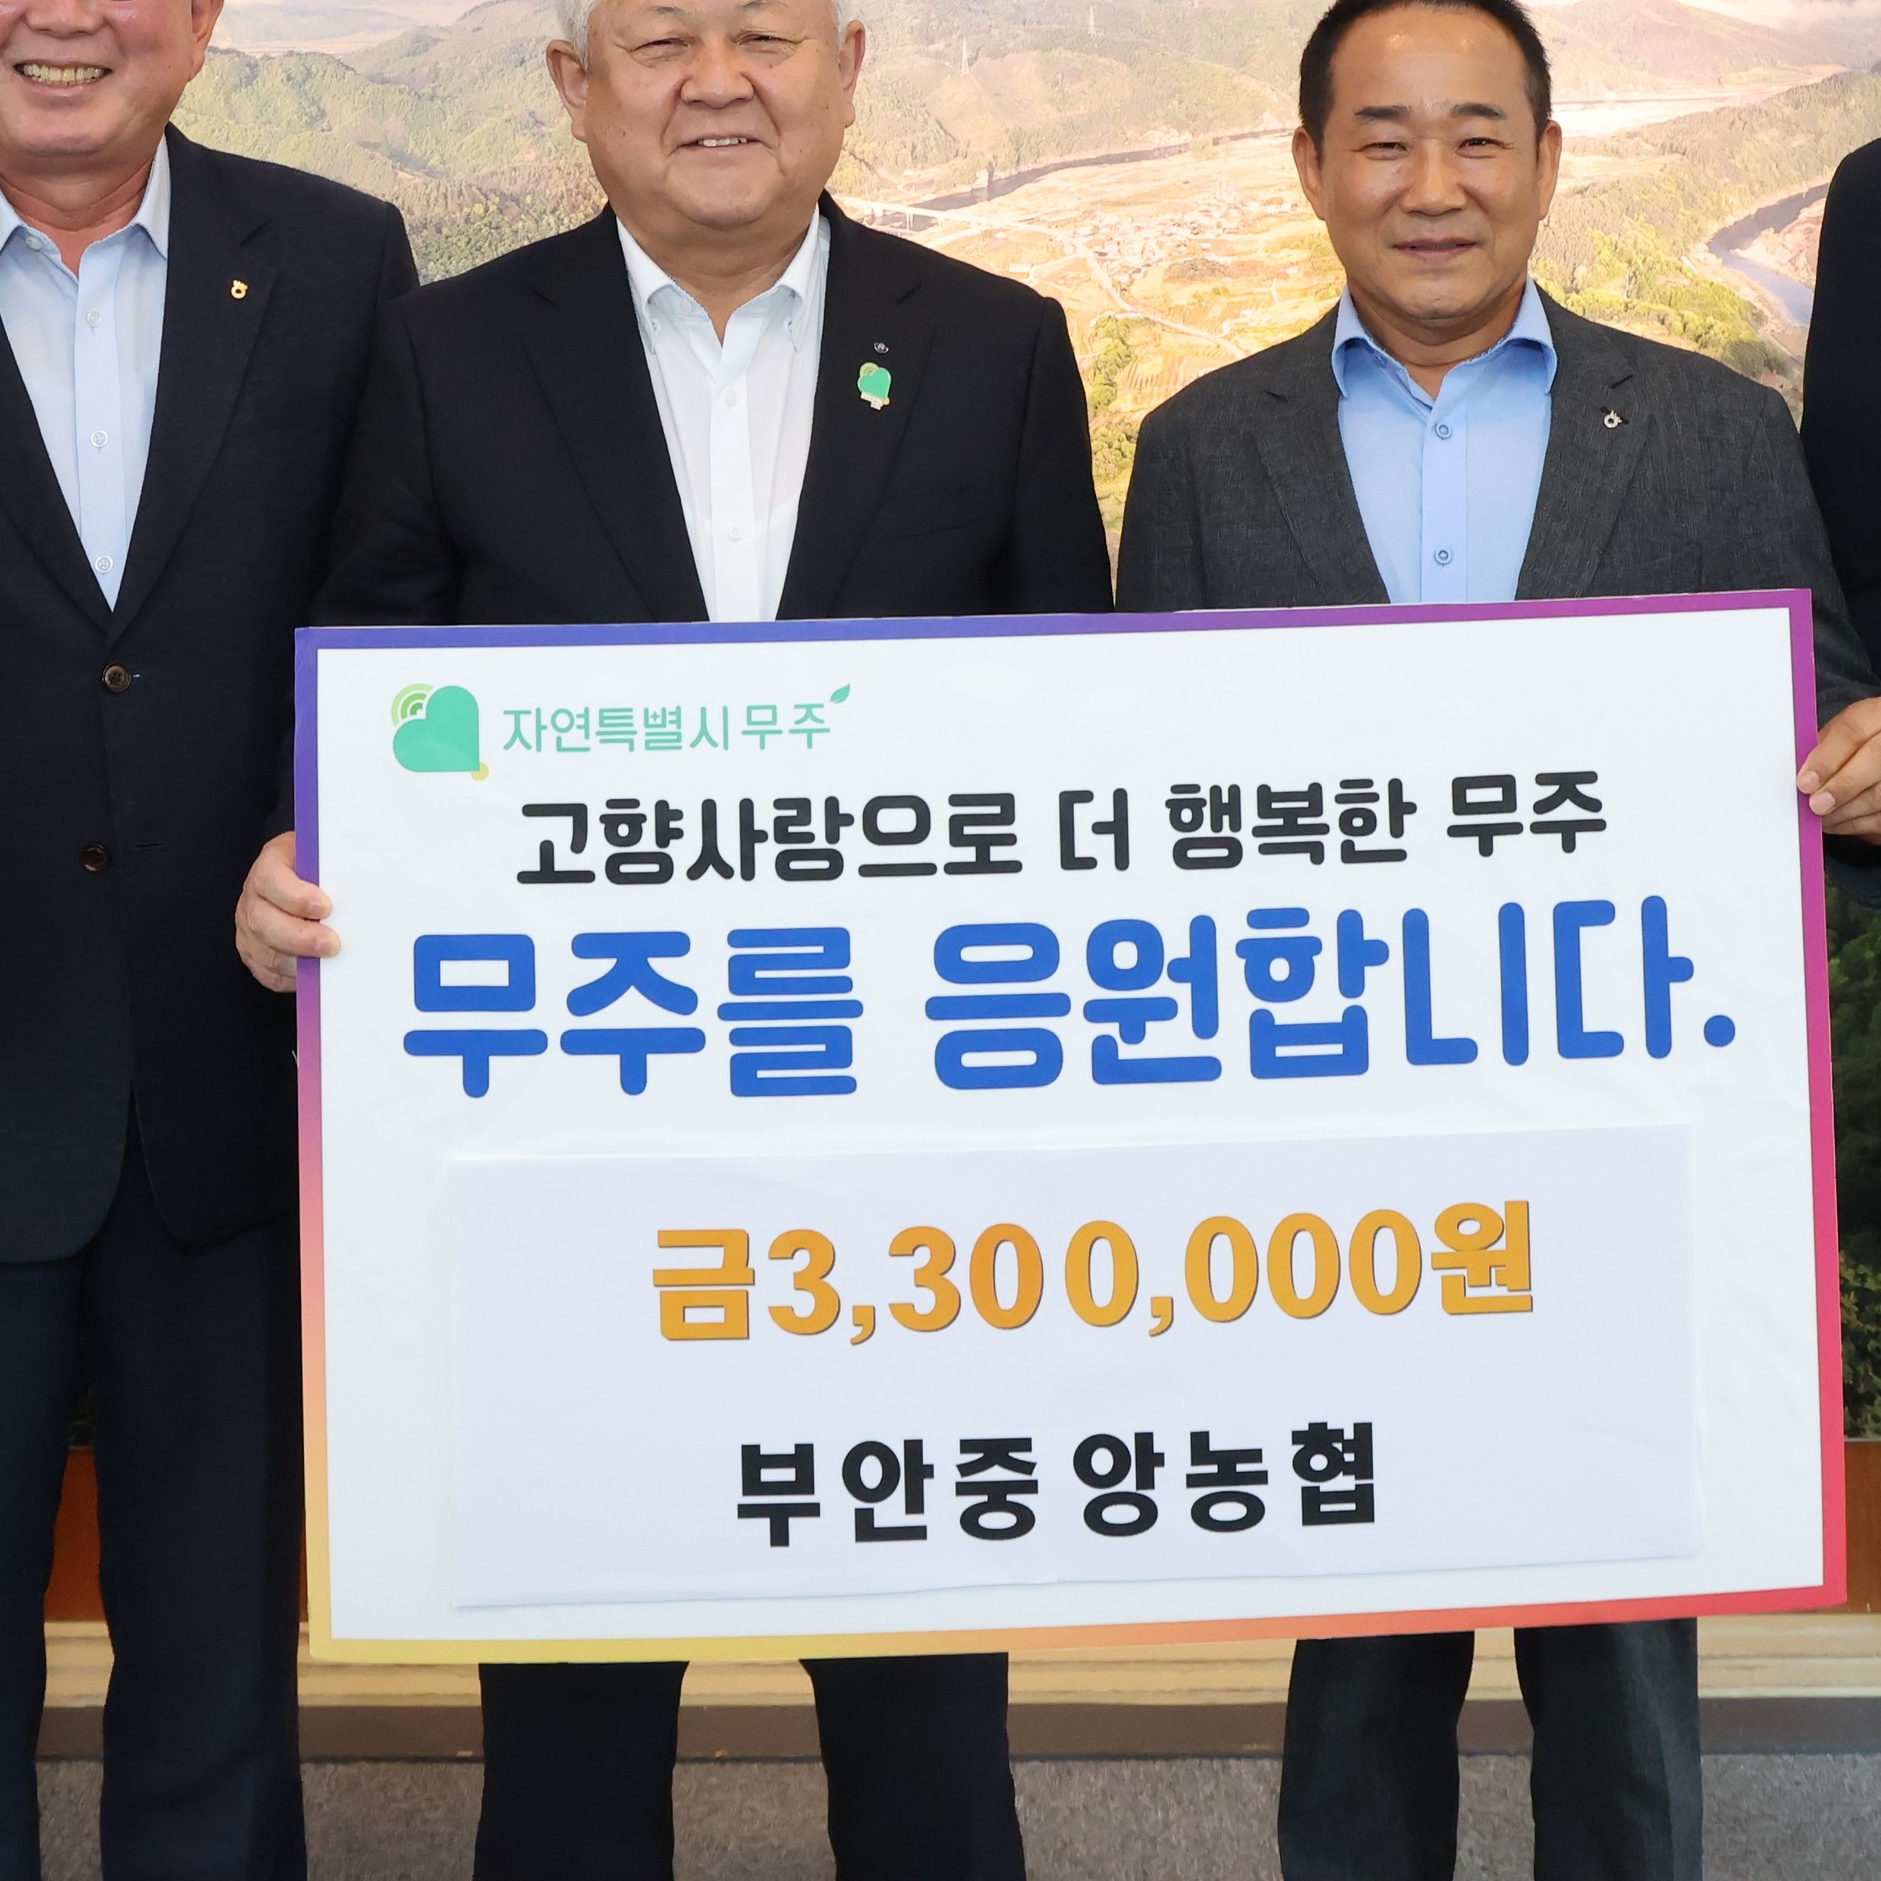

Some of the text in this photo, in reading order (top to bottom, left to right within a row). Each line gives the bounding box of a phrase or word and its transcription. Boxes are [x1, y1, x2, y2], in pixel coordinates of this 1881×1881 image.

[517, 772, 1606, 884] 고향사랑으로 더 행복한 무주
[405, 896, 1735, 1097] 무주를 응원합니다.
[654, 1201, 1532, 1344] 금3,300,000원
[738, 1423, 1374, 1546] 부안중앙농협
